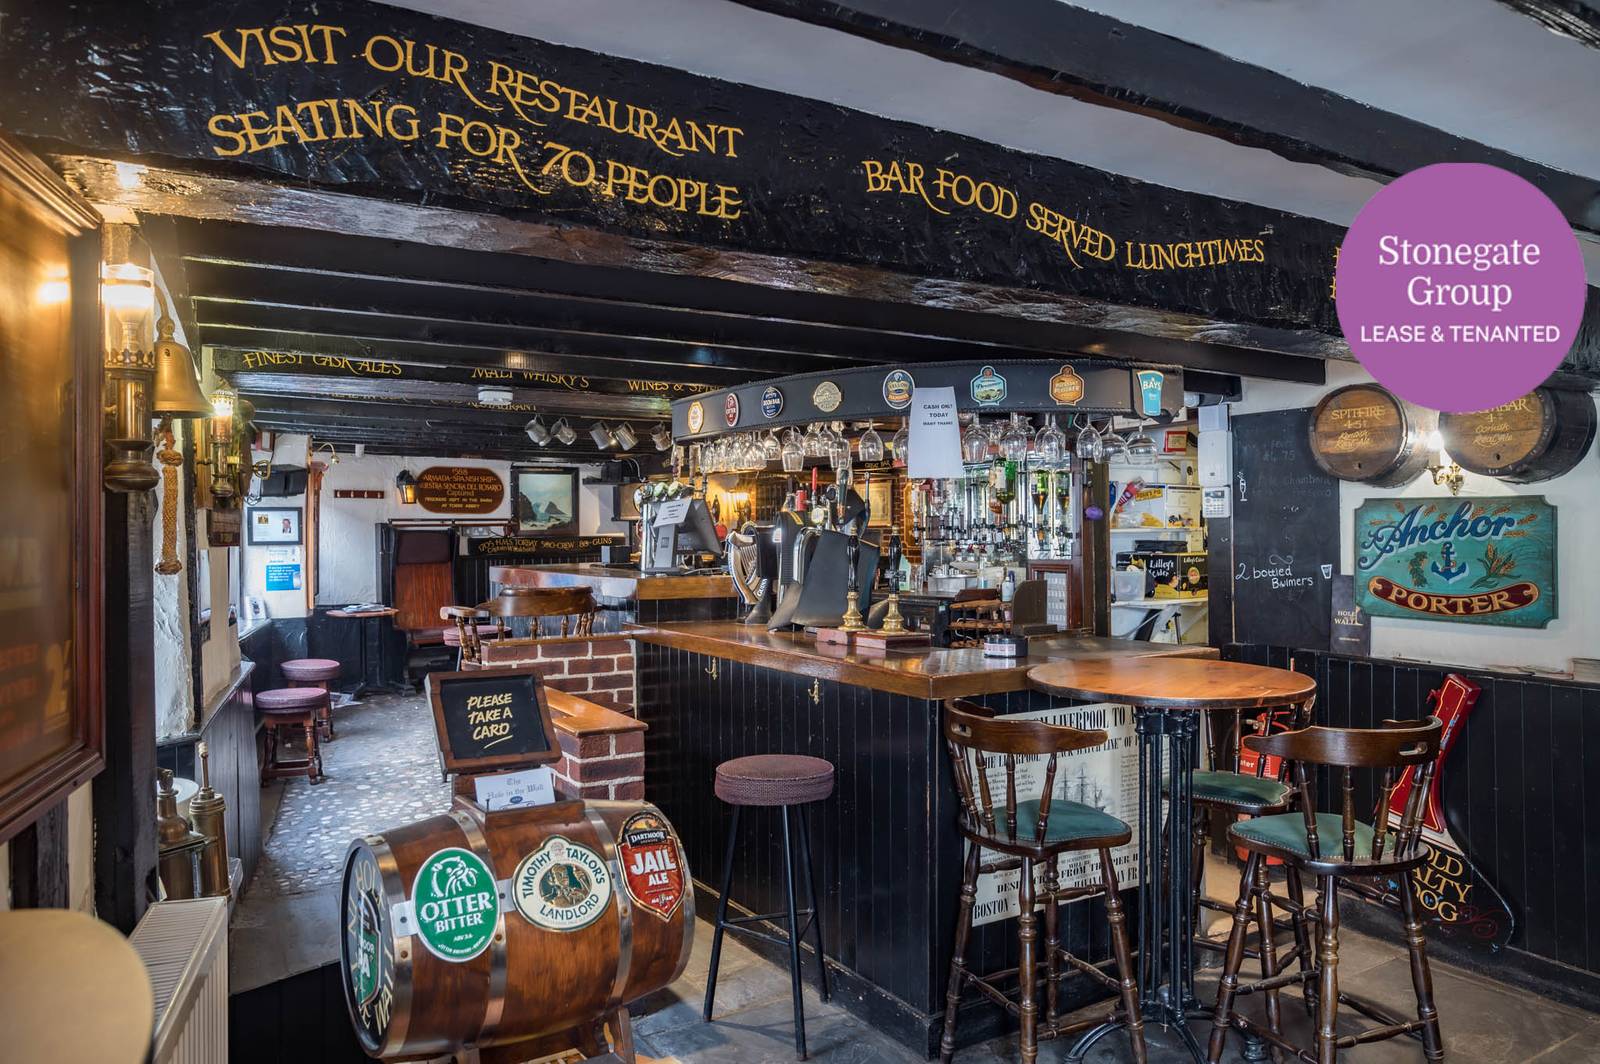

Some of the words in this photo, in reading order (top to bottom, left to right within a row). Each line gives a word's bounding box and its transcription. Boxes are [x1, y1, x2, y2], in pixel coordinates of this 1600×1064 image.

[203, 24, 347, 70] VISIT
[363, 35, 503, 112] OUR
[487, 61, 744, 158] RESTAURANT
[208, 98, 420, 157] SEATING
[431, 111, 551, 195] FOR
[543, 140, 596, 187] 70
[596, 159, 744, 220] PEOPLE
[861, 160, 951, 215] BAR
[932, 167, 1018, 220] FOOD
[1025, 202, 1117, 270] SERVED
[1124, 238, 1265, 271] LUNCHTIMES
[243, 351, 304, 368] FINEST
[313, 354, 364, 375] CASK
[359, 360, 402, 375] ALES
[628, 379, 669, 392] WINES
[673, 382, 685, 392] &
[1143, 380, 1161, 390] BAYS
[1331, 405, 1385, 421] SPITFIRE
[1358, 500, 1518, 570] Anchor
[1149, 559, 1174, 571] Lilley's
[1151, 568, 1170, 578] Cider
[1235, 563, 1251, 580] 2
[1253, 566, 1293, 579] bottled
[1271, 577, 1314, 589] Bulmers
[1387, 584, 1513, 614] PORTER
[467, 693, 513, 710] PLEASE
[468, 708, 501, 725] TAKE
[503, 707, 513, 719] A
[1112, 707, 1126, 727] TO
[472, 723, 510, 740] CARD
[984, 756, 996, 769] HE
[630, 831, 665, 843] DARTMOOR
[630, 849, 677, 876] JAIL
[1061, 865, 1086, 879] FROM
[522, 851, 552, 899] TIMOTHY
[565, 847, 606, 885] TAYLOR'S
[648, 872, 669, 887] ALE
[1411, 866, 1473, 904] ALTY
[420, 892, 494, 923] OTTER
[540, 893, 600, 921] LANDLORD
[974, 897, 1009, 920] BOSTON
[435, 912, 484, 934] BITTER
